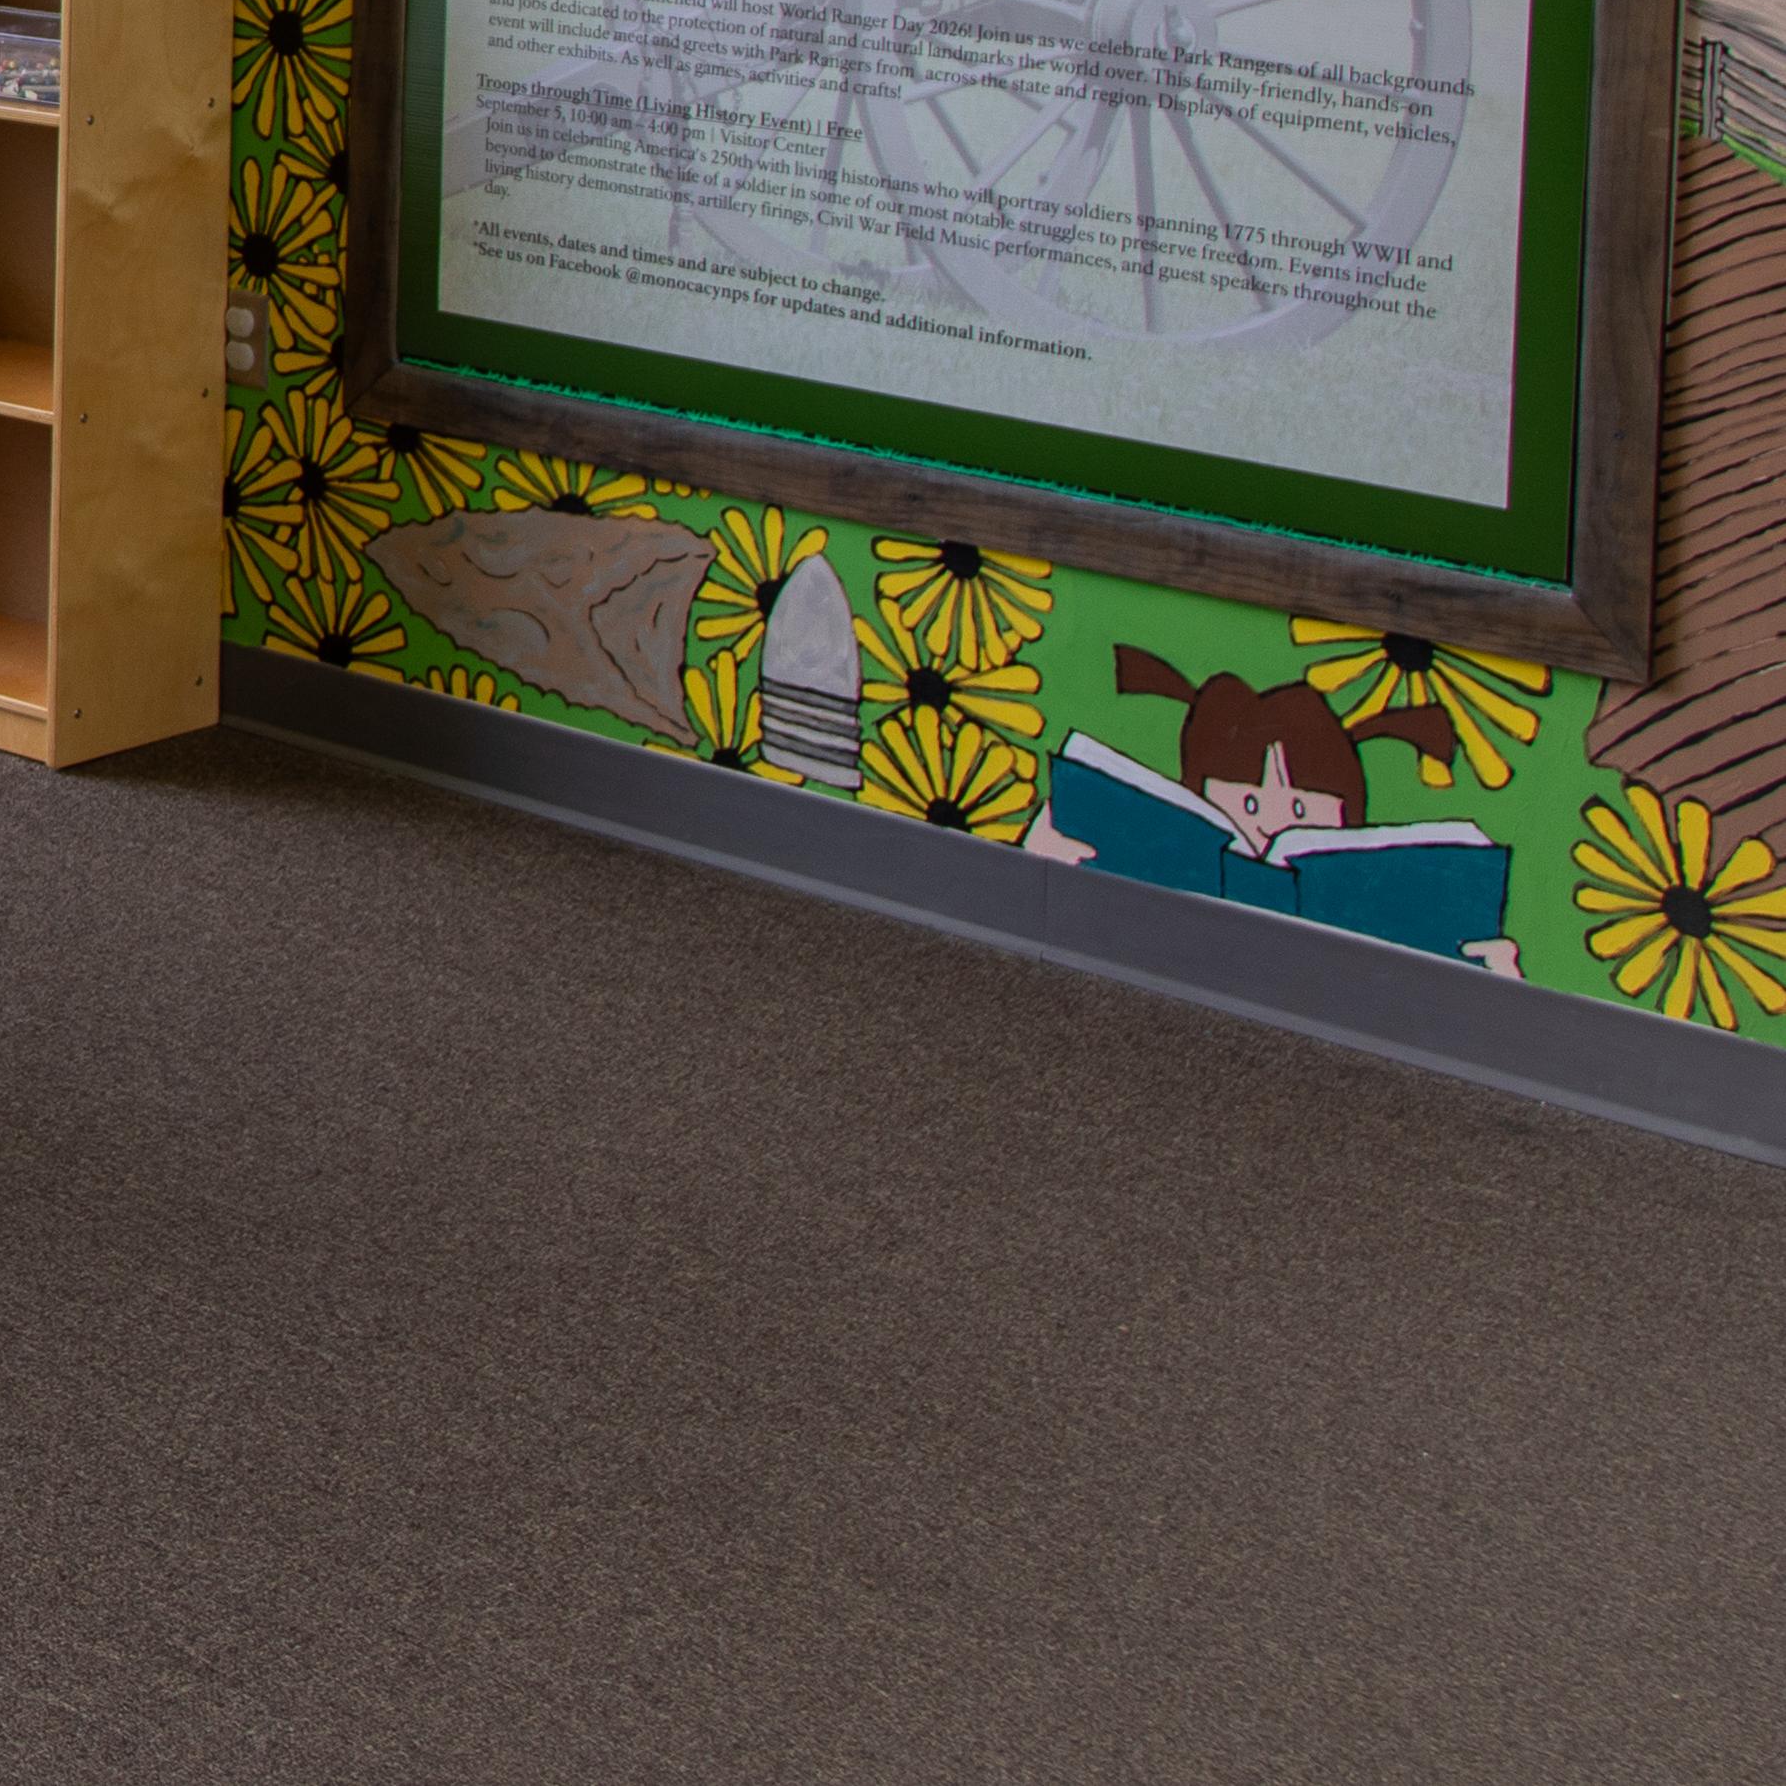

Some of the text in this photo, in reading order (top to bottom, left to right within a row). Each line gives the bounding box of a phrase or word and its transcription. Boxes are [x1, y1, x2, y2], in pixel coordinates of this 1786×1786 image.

[483, 179, 511, 200] day.
[503, 225, 552, 249] events,
[557, 234, 595, 254] dates
[600, 241, 627, 259] and
[632, 246, 673, 267] times
[678, 254, 706, 272] and
[711, 263, 735, 277] are
[739, 264, 795, 290] subject
[801, 274, 817, 291] to
[822, 278, 886, 306] change.
[507, 250, 522, 262] us
[526, 253, 544, 266] on
[549, 254, 621, 279] Facebook
[754, 288, 777, 306] for
[782, 293, 845, 321] updates
[850, 305, 880, 324] and
[886, 311, 972, 340] additional
[979, 327, 1093, 361] information.
